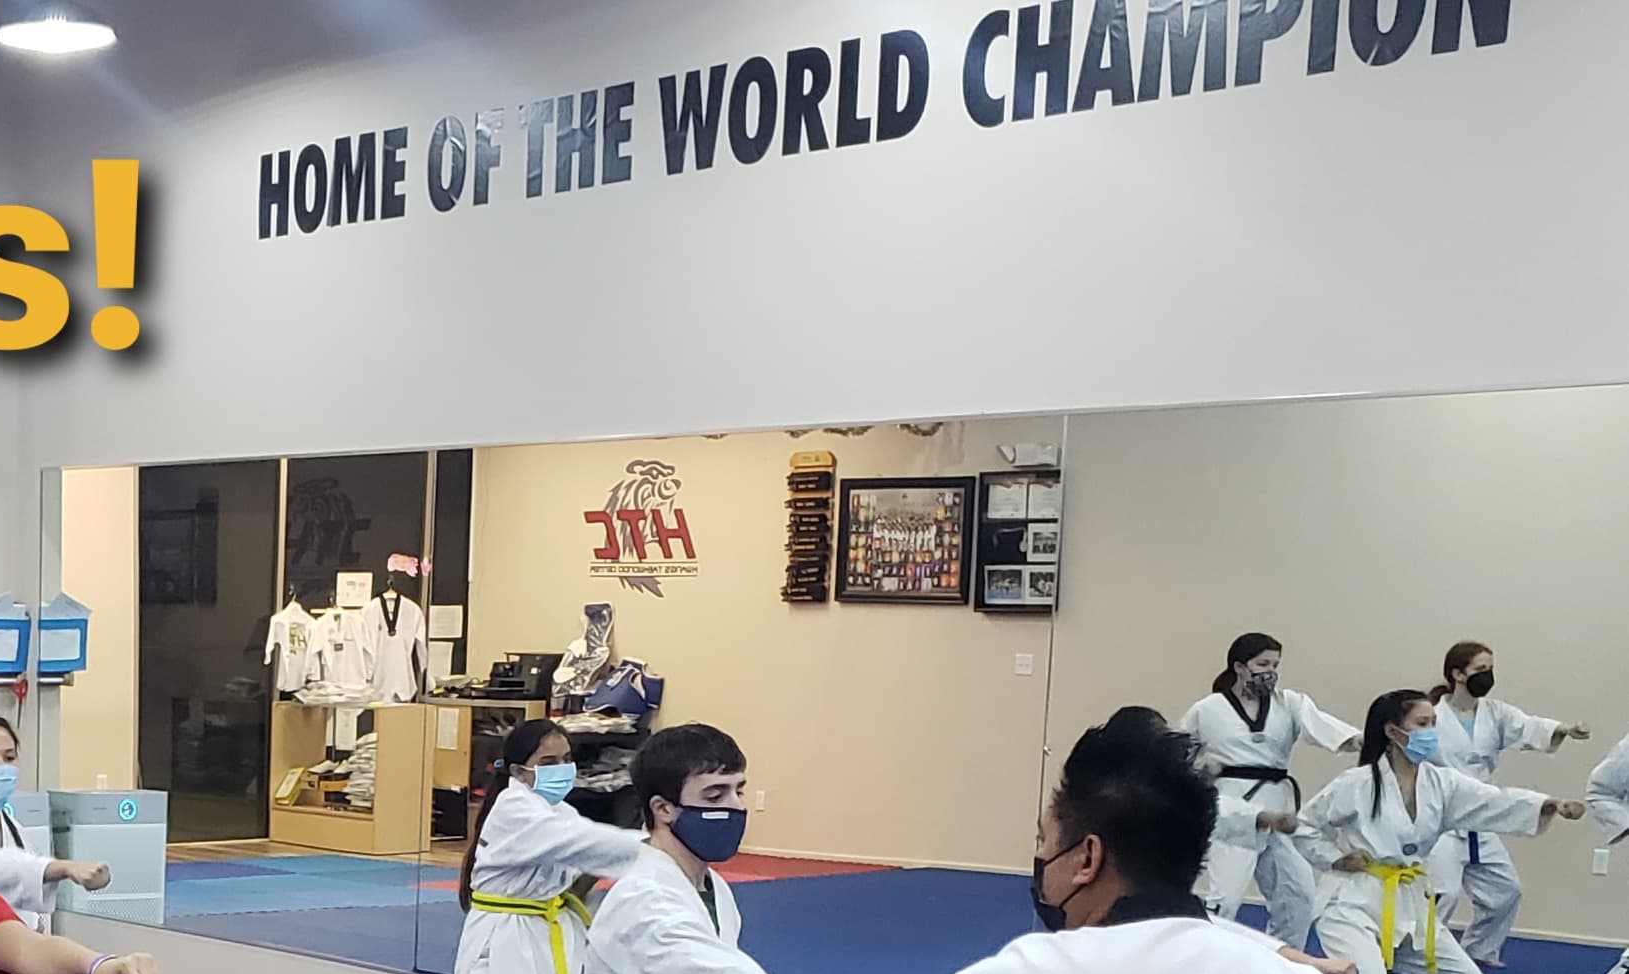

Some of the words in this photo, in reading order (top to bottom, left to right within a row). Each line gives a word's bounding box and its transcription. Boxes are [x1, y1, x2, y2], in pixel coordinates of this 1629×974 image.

[258, 126, 408, 240] HOME
[427, 108, 505, 213] OF
[518, 81, 635, 199] THE
[658, 29, 930, 176] WORLD
